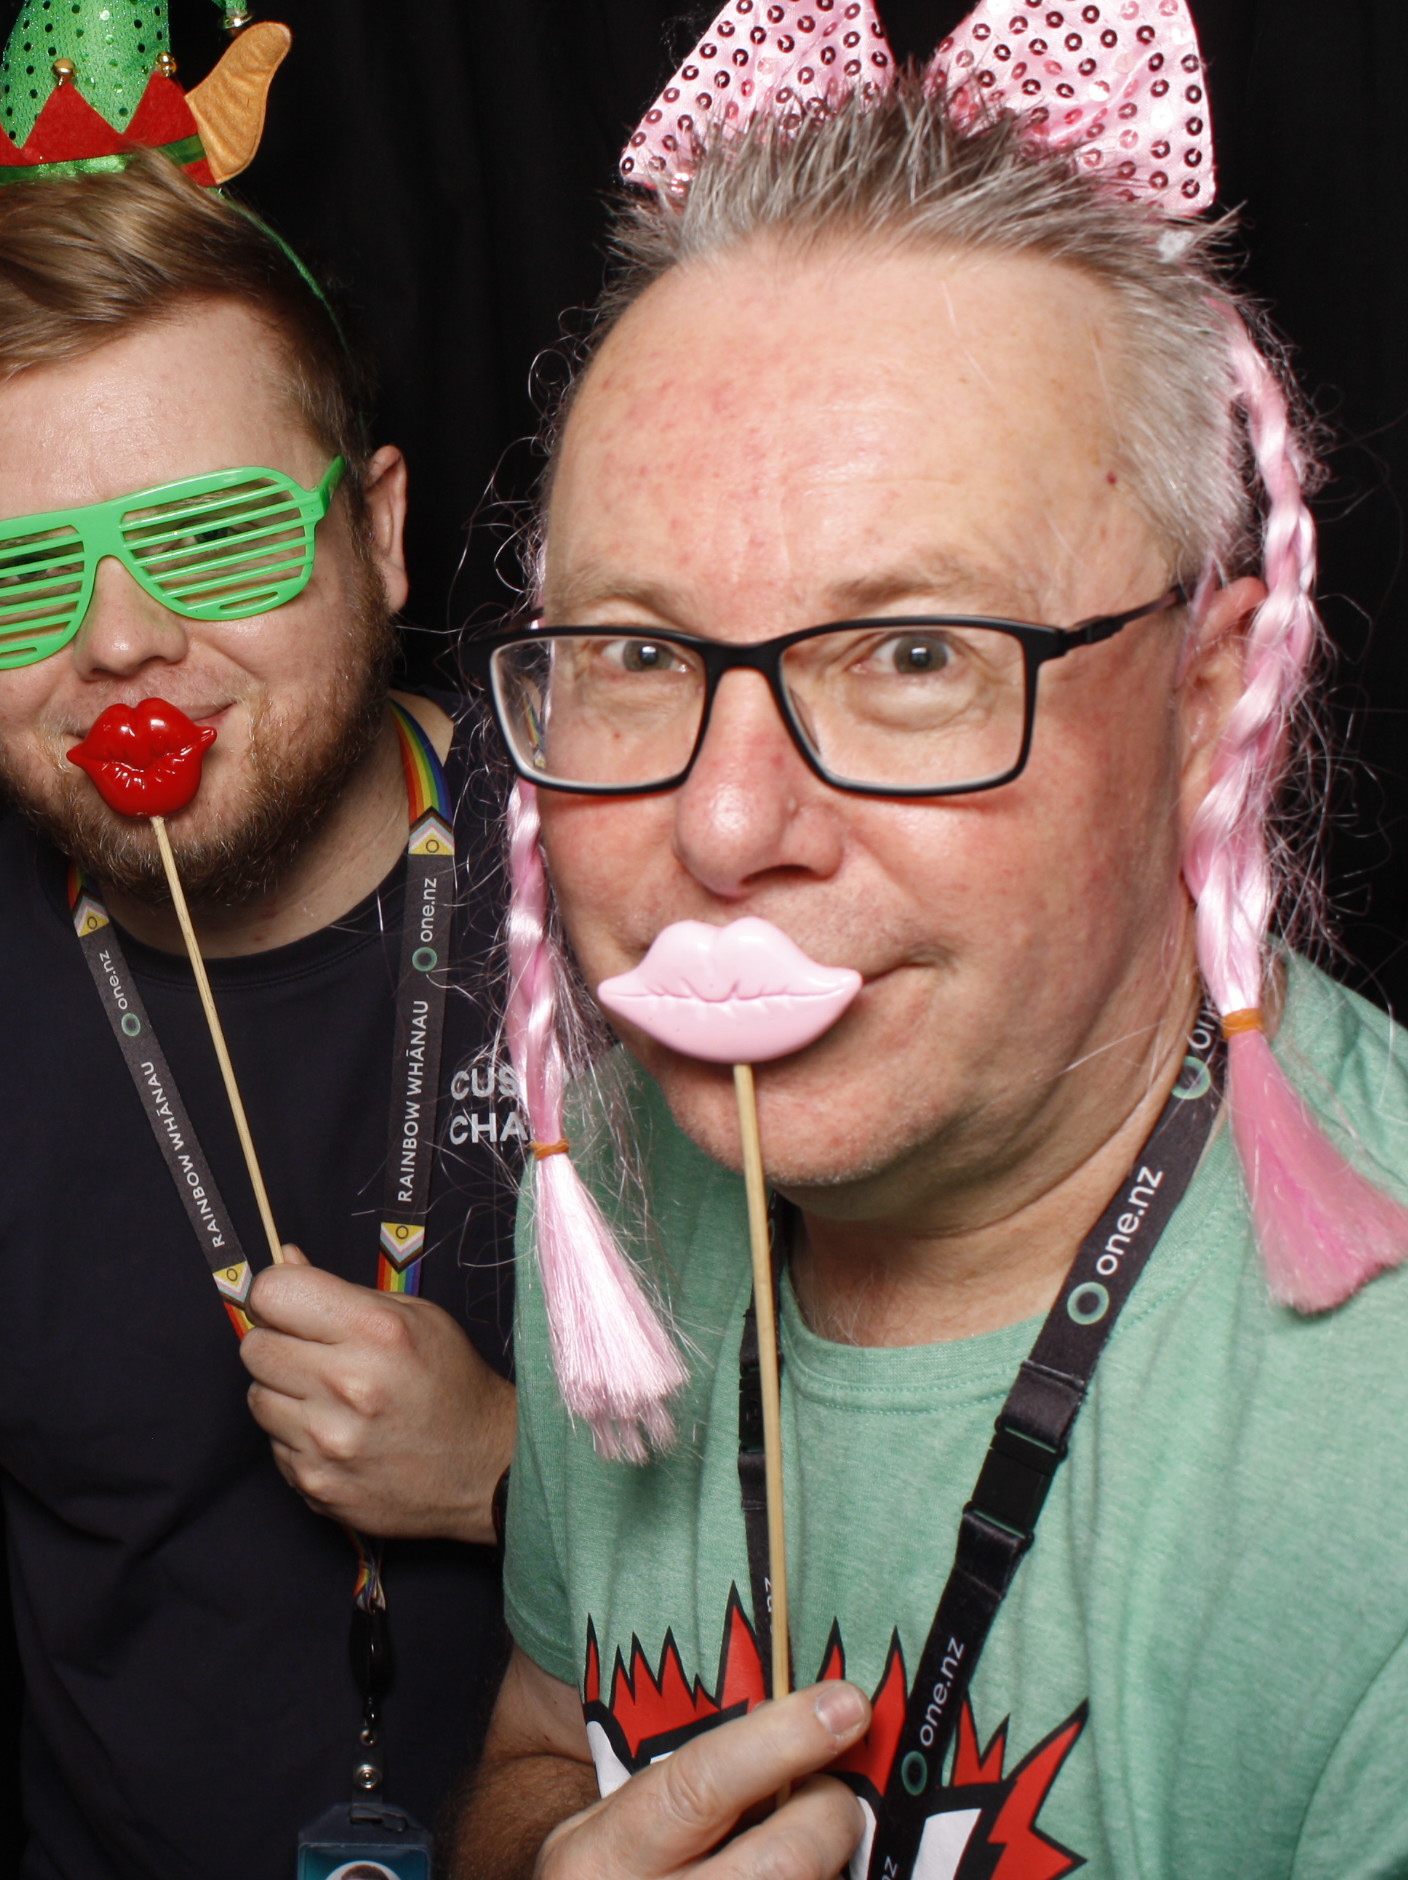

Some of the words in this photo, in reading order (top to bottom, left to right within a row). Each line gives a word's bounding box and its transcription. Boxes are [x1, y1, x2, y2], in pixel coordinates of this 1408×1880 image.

[420, 877, 437, 943] one.nz
[99, 949, 128, 1011] one.nz
[405, 1000, 429, 1096] WHĀNAU
[140, 1061, 185, 1151] WHĀNAU
[398, 1100, 421, 1202] RAINBOW
[177, 1154, 226, 1248] RAINBOW
[1095, 1164, 1163, 1276] one.nz
[919, 1637, 965, 1748] one.nz
